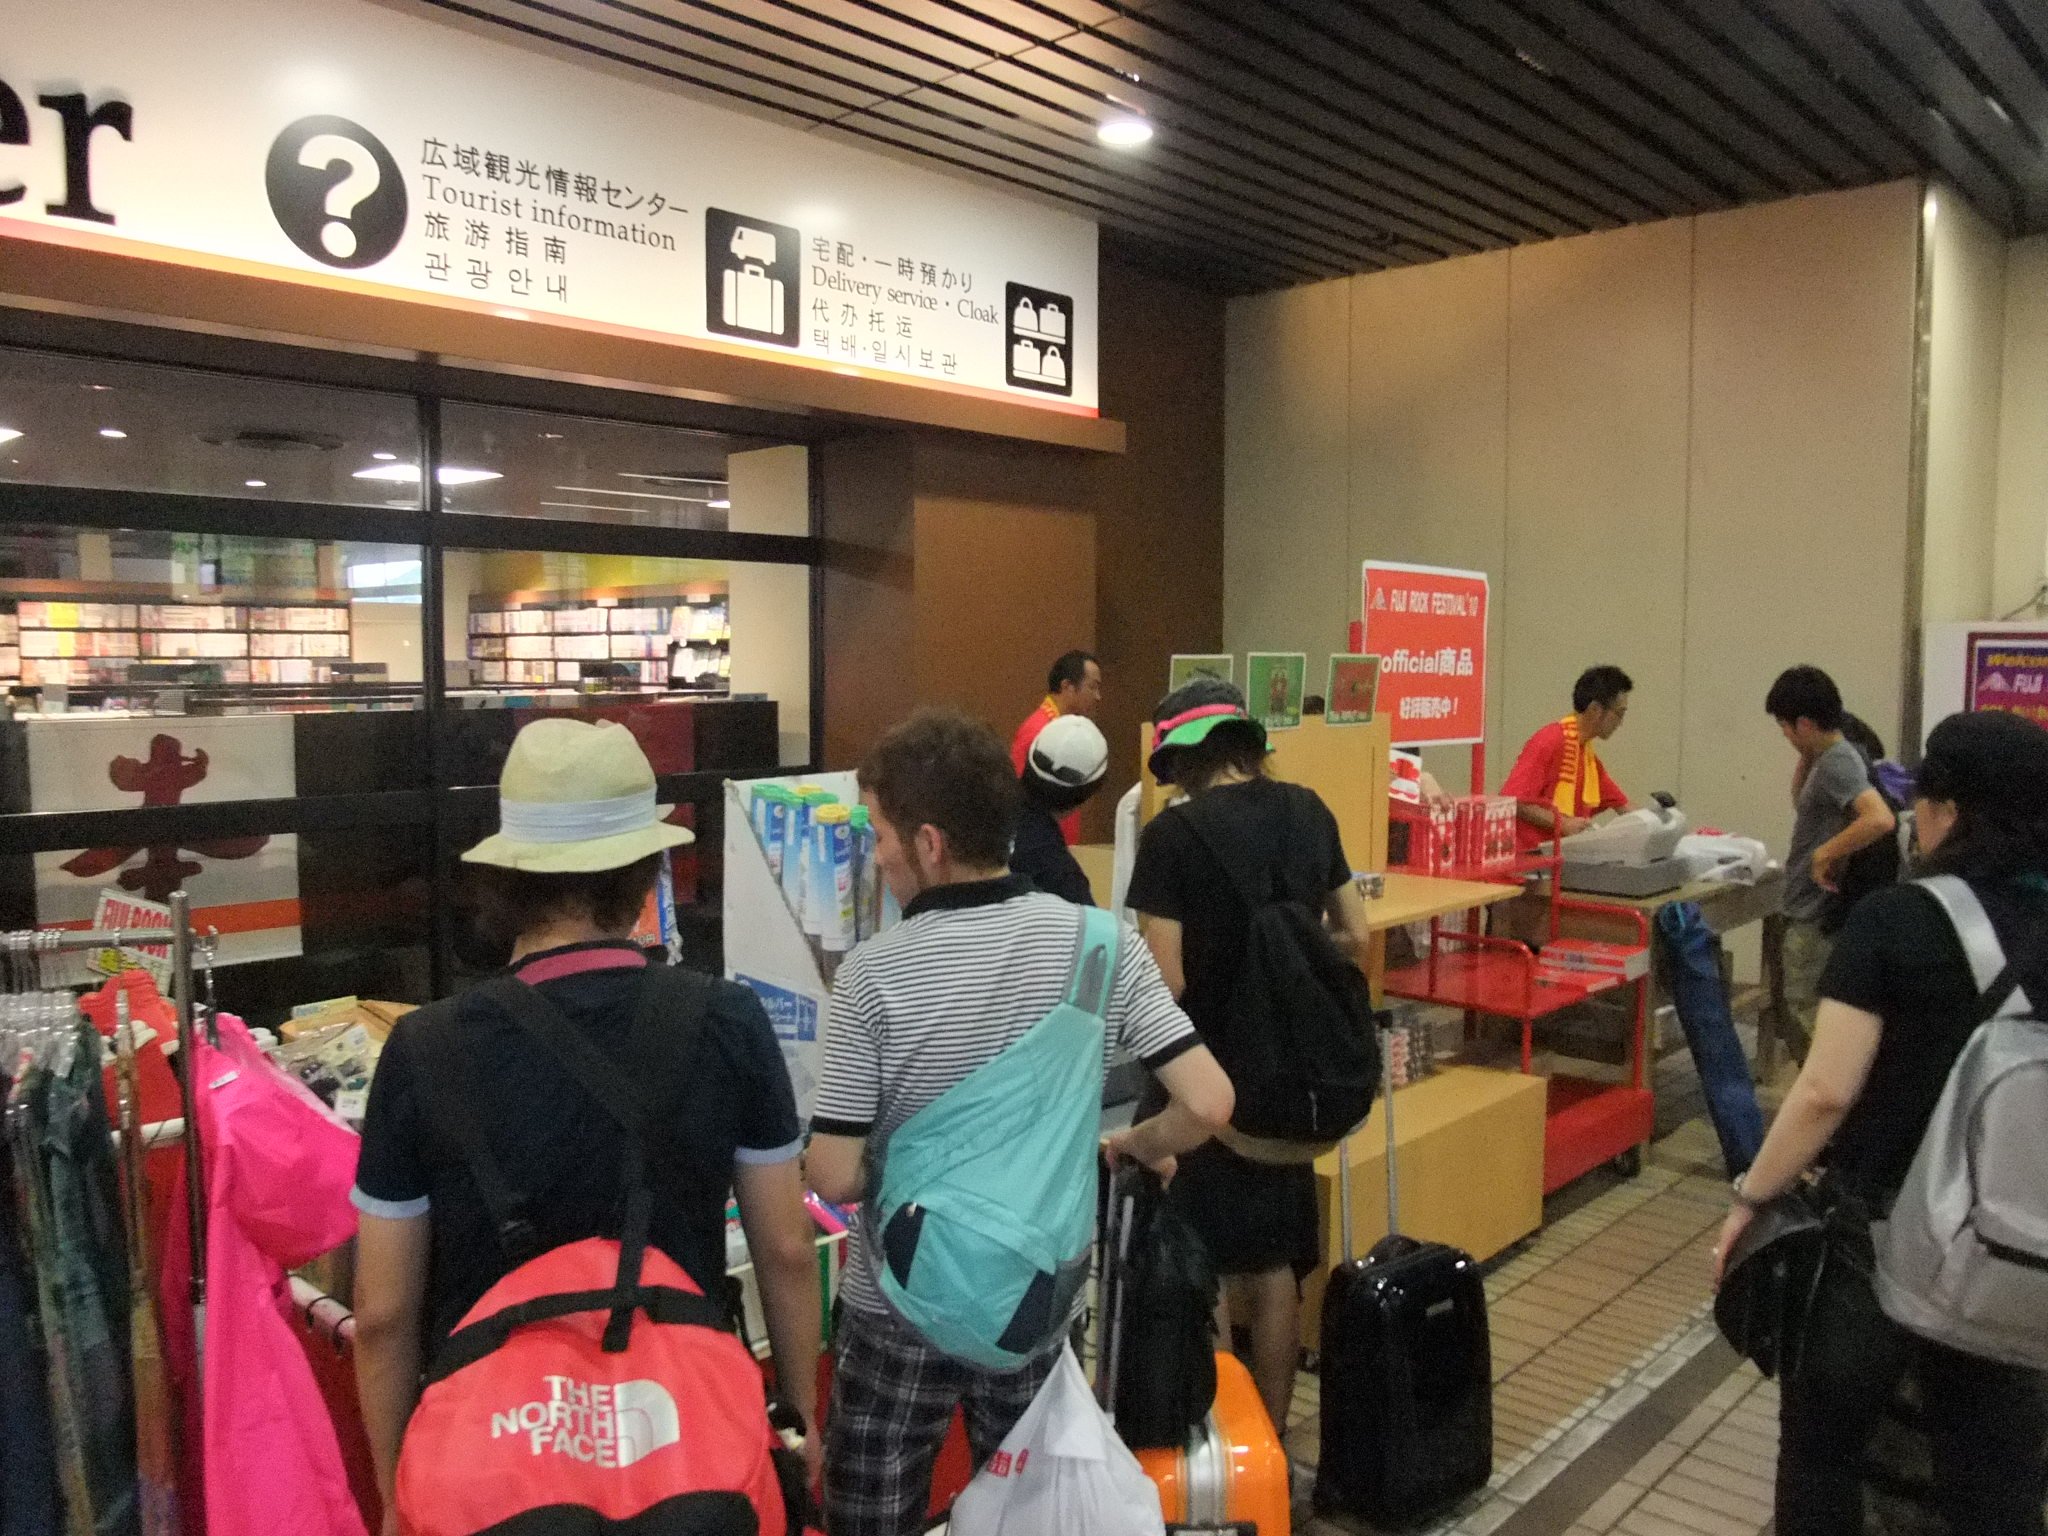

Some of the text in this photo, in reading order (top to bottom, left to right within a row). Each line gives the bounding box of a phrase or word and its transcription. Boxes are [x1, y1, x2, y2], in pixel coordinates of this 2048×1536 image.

[420, 137, 689, 217] 広域観光情報センター
[423, 174, 677, 251] Tourist information
[424, 211, 566, 264] 旅游指南
[424, 252, 567, 303] 관광안내
[812, 266, 999, 324] Delivery service Cloak
[543, 1375, 611, 1412] THE
[491, 1401, 615, 1440] NORTH
[531, 1426, 617, 1469] FACE
